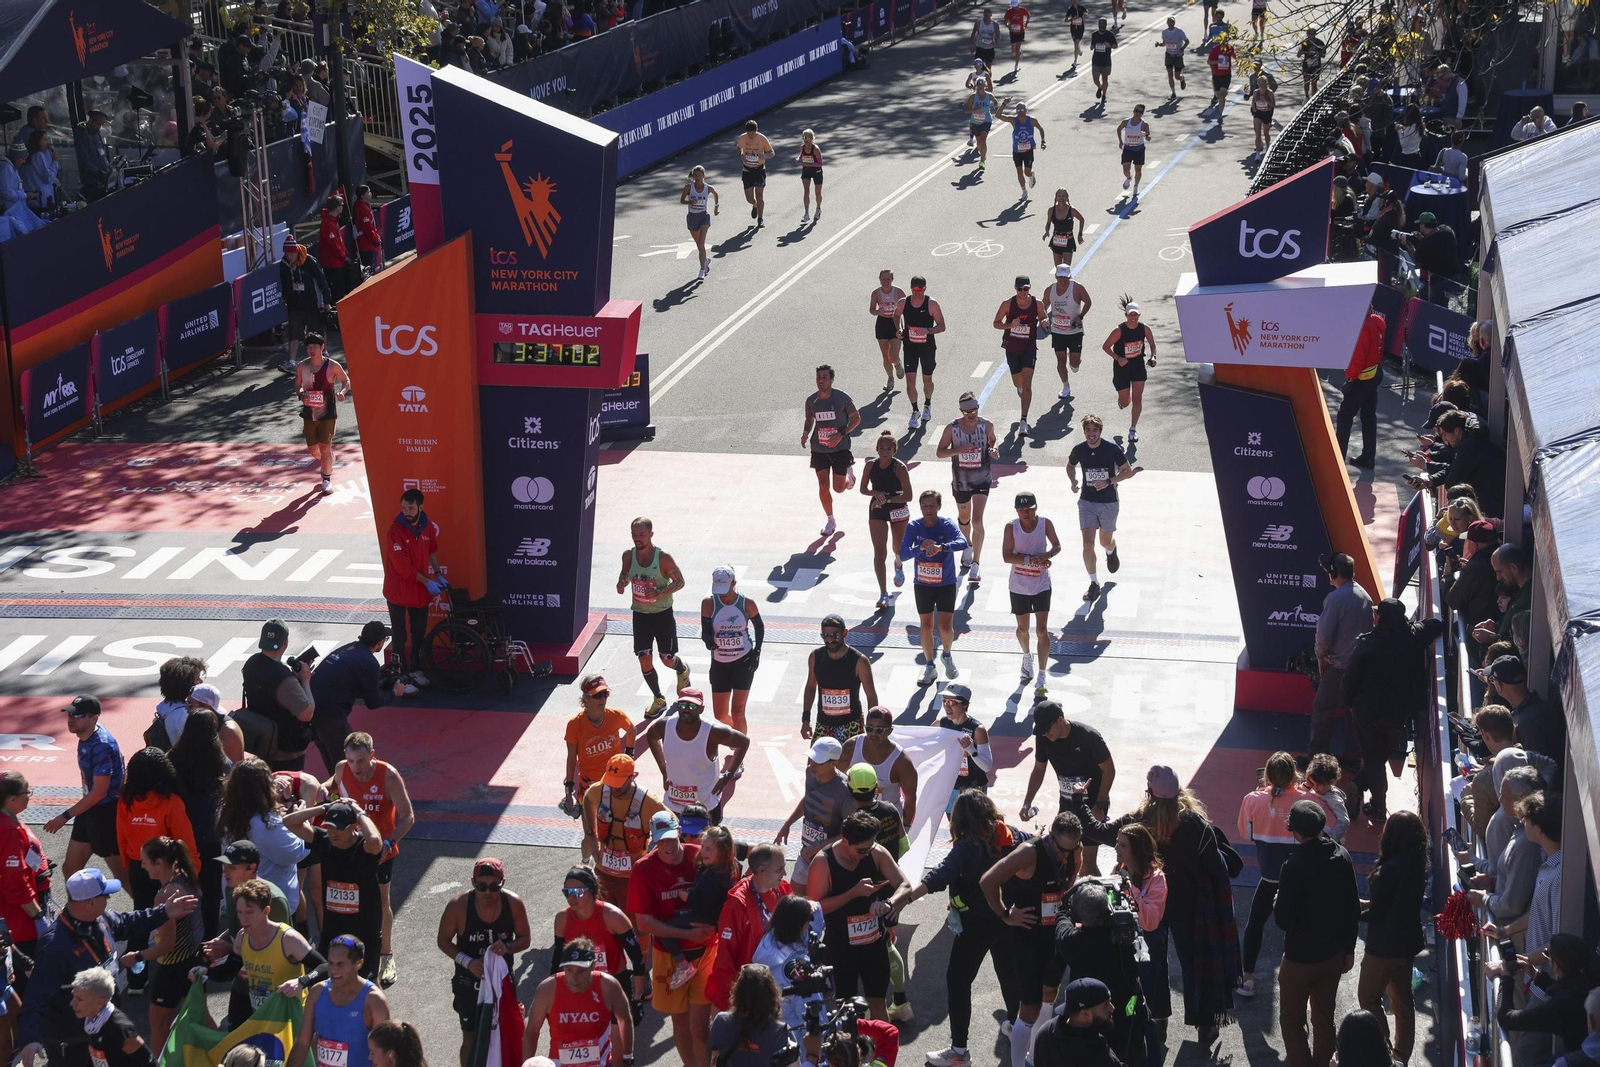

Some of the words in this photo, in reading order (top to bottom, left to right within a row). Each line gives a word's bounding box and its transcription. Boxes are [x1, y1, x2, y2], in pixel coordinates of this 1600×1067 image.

[530, 82, 551, 100] MOVE
[551, 76, 567, 90] YOU
[407, 84, 438, 171] 2025
[1239, 220, 1301, 260] tcs
[490, 247, 517, 265] tcs
[492, 270, 517, 278] NEW
[520, 270, 552, 280] YORK
[554, 271, 578, 280] CITY
[492, 282, 558, 292] MARATHON
[184, 316, 208, 330] UNITED
[1261, 320, 1280, 332] tcs
[180, 324, 209, 340] AIRLINES
[375, 316, 438, 356] tcs
[1260, 342, 1304, 350] MARATHON
[1449, 338, 1466, 348] WORLD
[1448, 344, 1473, 357] MARATHO
[110, 355, 126, 376] tcs
[398, 404, 428, 412] TATA
[508, 438, 558, 450] Citizens
[1234, 447, 1273, 458] Citizens
[1268, 542, 1298, 550] balance
[525, 558, 558, 566] balance
[919, 566, 940, 576] 14589
[718, 638, 741, 646] 11436
[823, 696, 848, 704] 14839
[670, 788, 696, 800] 10394
[804, 826, 824, 840] 13829
[604, 854, 628, 868] 13310
[330, 888, 356, 901] 12133
[852, 919, 878, 934] 14722
[244, 961, 274, 975] BRASIL
[559, 1012, 600, 1024] NYAC
[568, 1048, 590, 1060] 743
